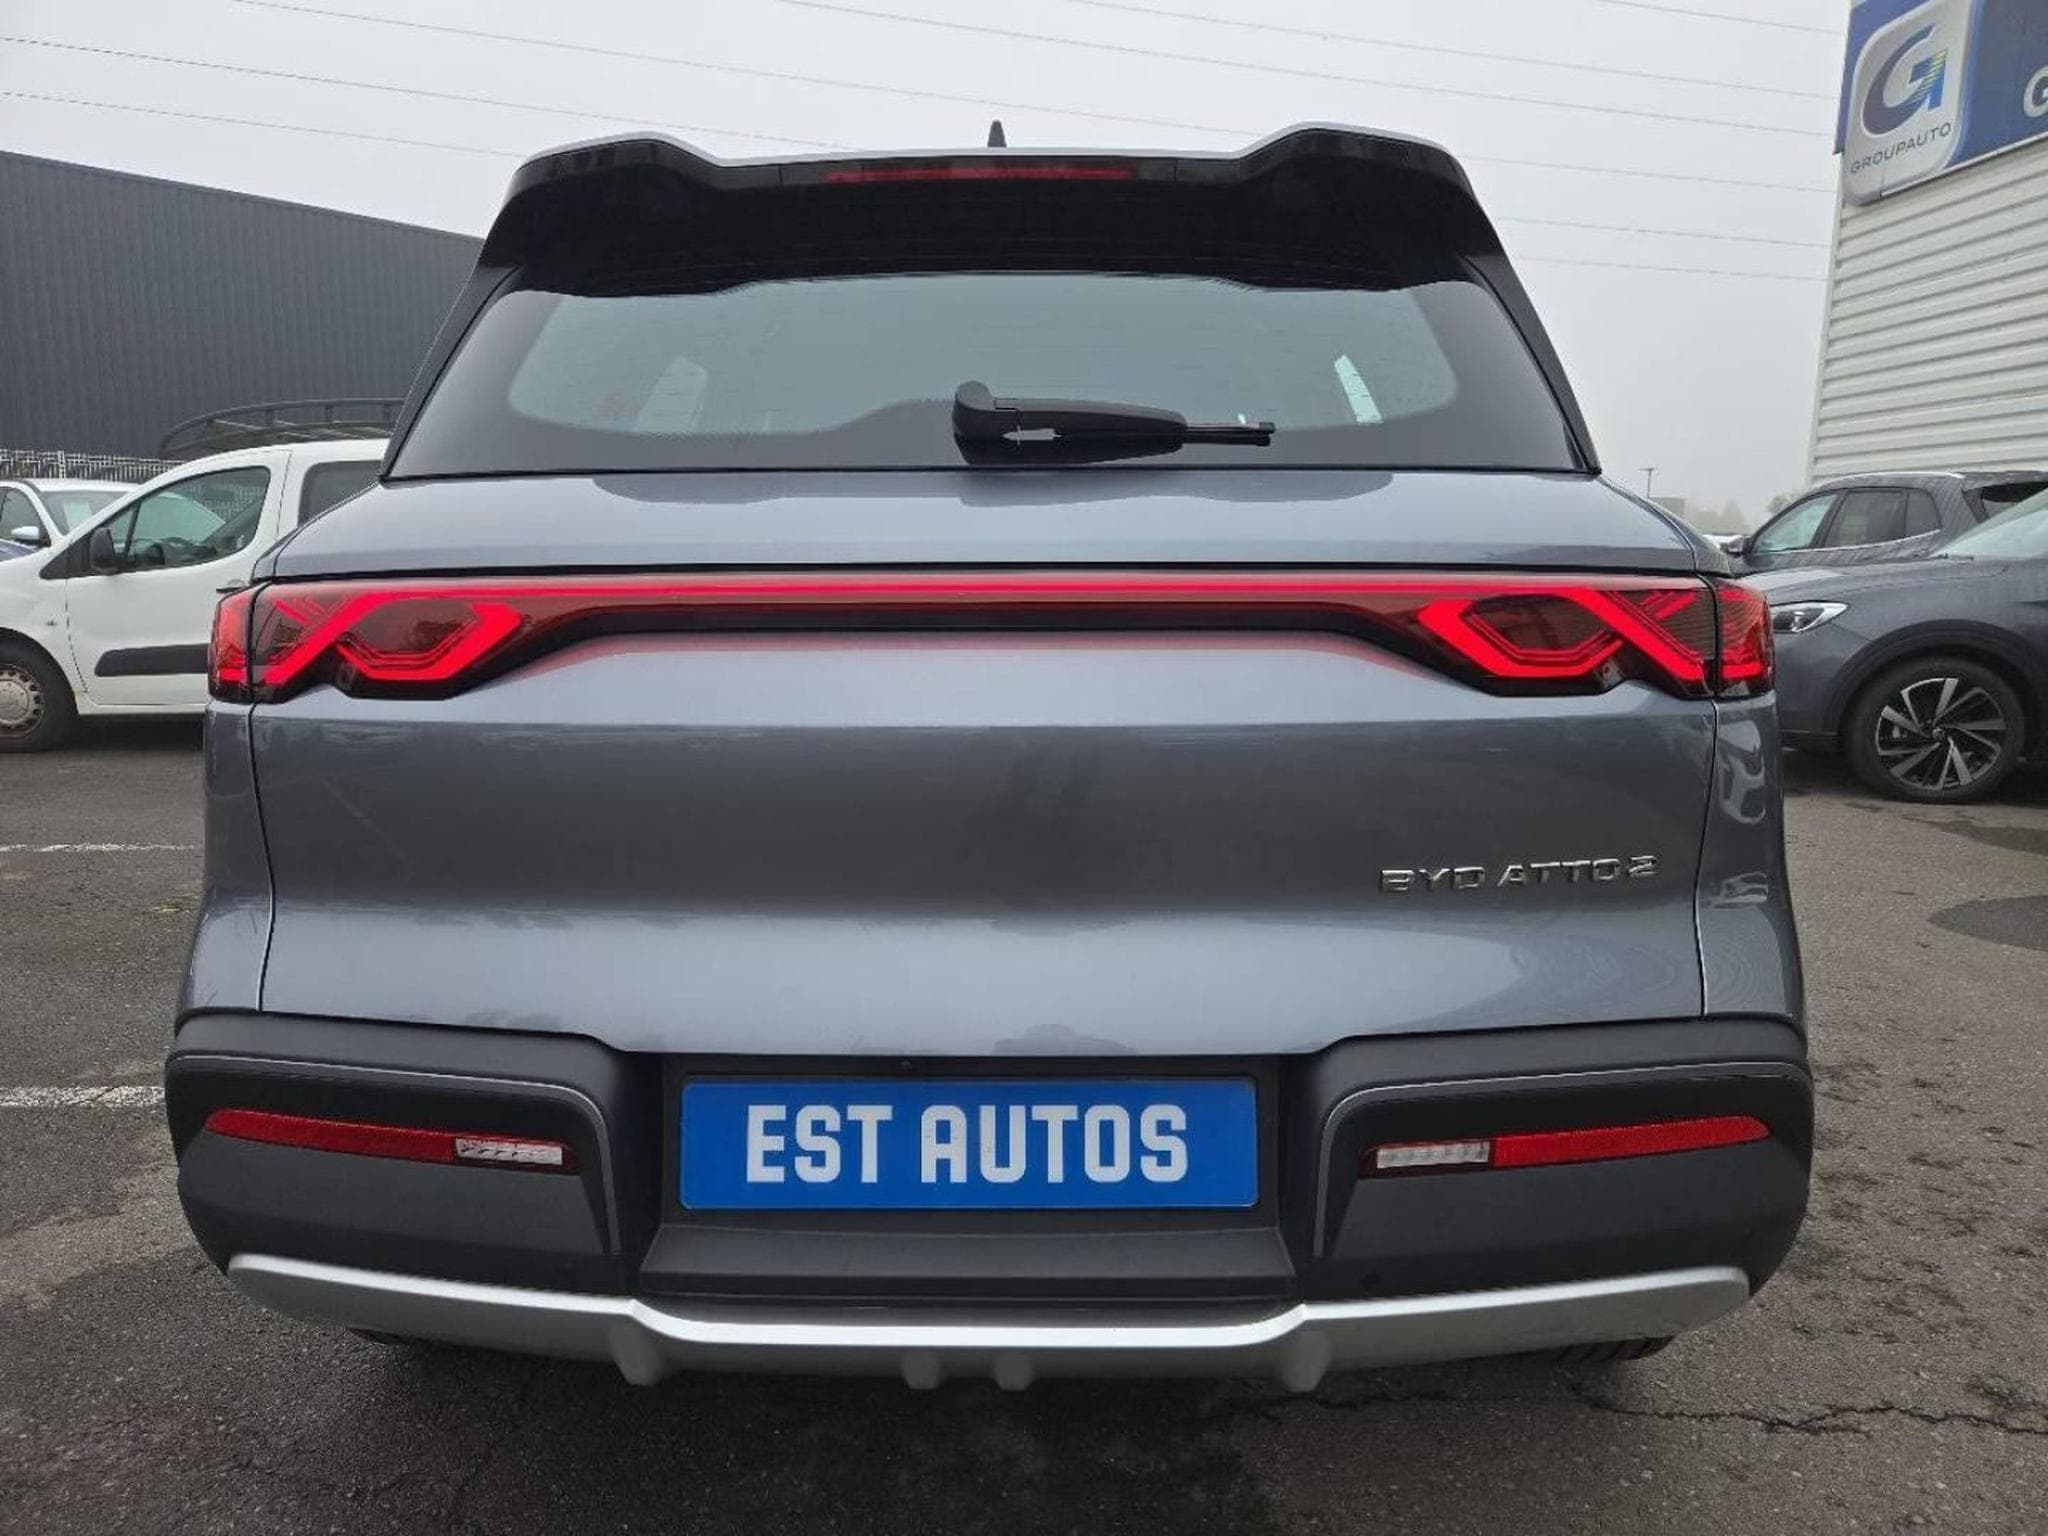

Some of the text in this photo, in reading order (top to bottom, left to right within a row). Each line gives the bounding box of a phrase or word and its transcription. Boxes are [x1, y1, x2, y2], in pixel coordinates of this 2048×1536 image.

[1851, 122, 1951, 174] GROUPAUTO
[1380, 866, 1485, 891] BYD
[746, 1104, 1188, 1184] EST AUTOS
